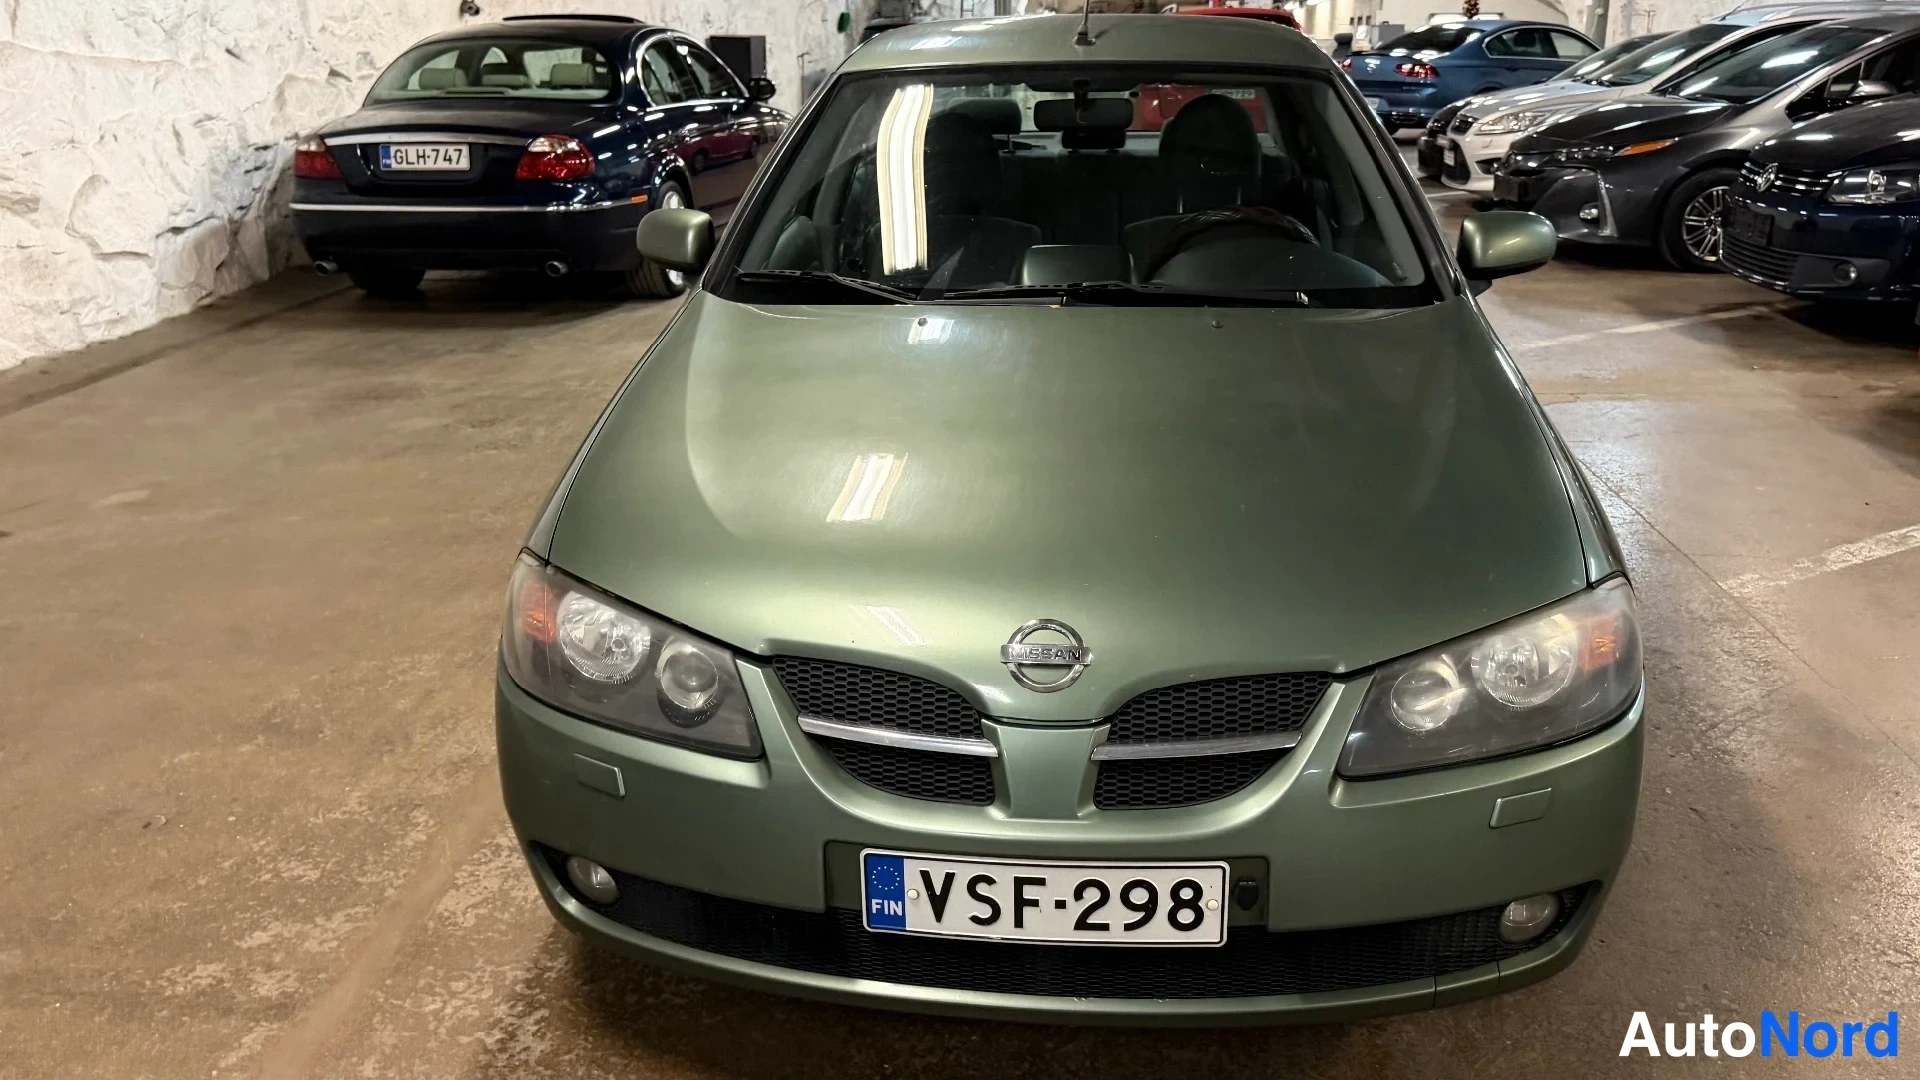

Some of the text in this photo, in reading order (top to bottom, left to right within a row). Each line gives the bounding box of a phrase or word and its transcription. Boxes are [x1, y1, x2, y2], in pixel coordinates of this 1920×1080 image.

[393, 148, 463, 165] GLH-747
[1008, 647, 1082, 662] NISSAN
[871, 869, 1205, 932] FIN VSF-298
